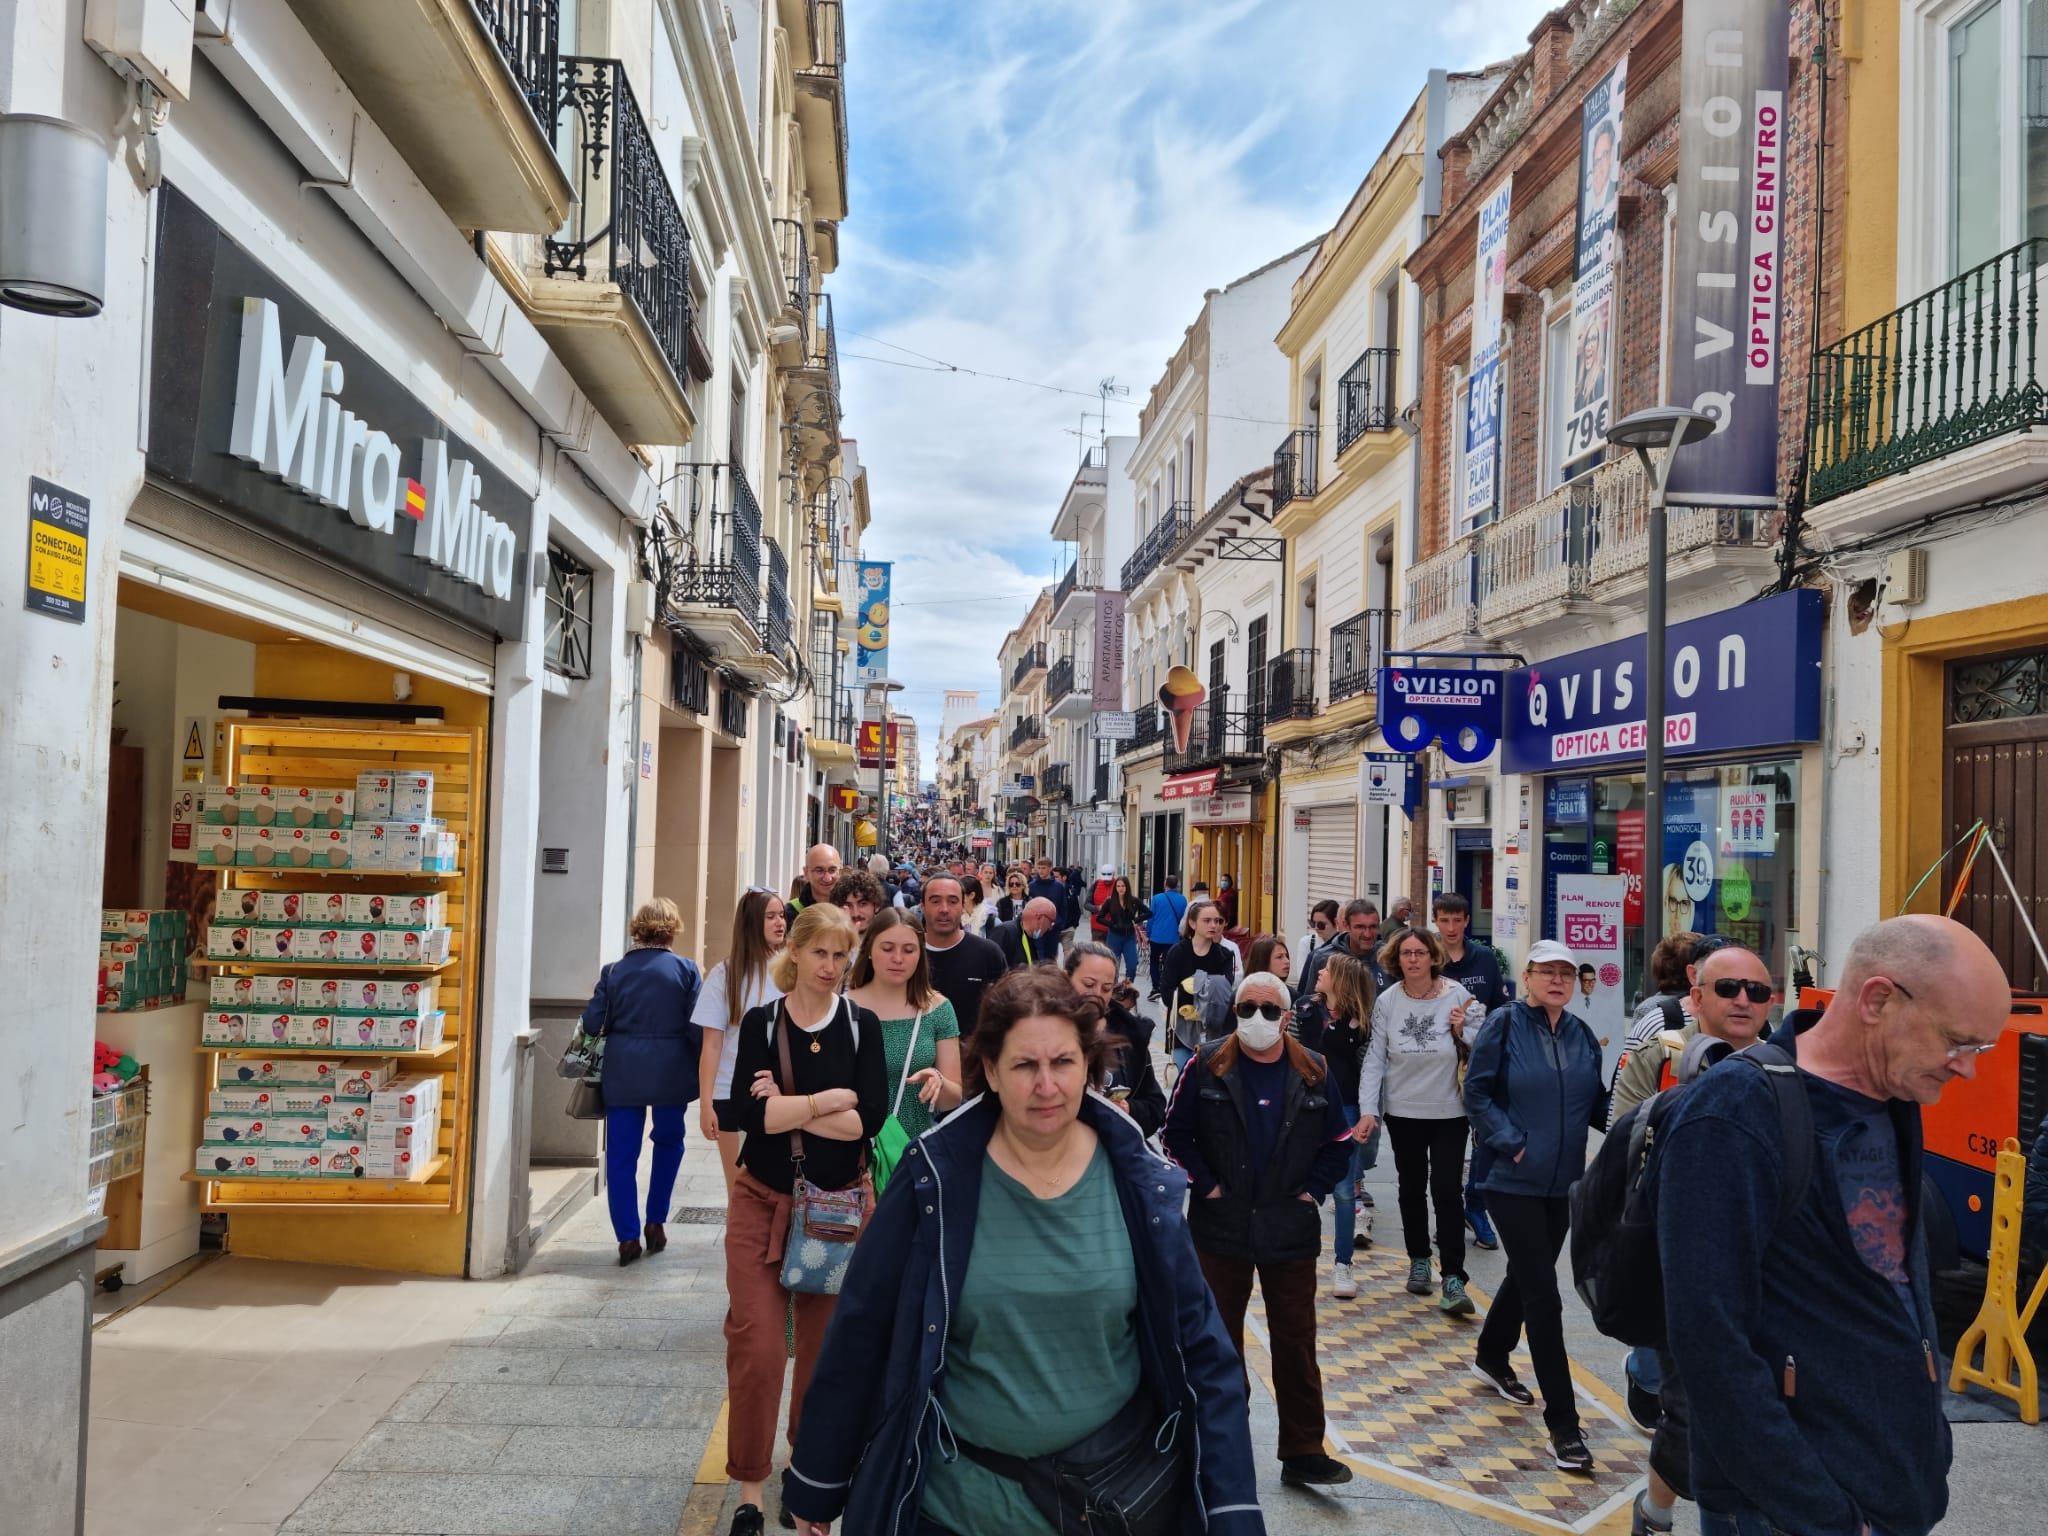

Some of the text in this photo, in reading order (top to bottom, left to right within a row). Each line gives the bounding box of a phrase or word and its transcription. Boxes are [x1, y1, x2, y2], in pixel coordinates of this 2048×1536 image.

[1481, 186, 1510, 234] PLAN
[1480, 216, 1510, 257] RENOVE
[1747, 106, 1778, 369] ÓPTICA CENTRO
[1577, 261, 1614, 297] CRISTALES
[1575, 280, 1613, 318] INCLUIDOS
[1469, 364, 1499, 432] 50€
[1567, 400, 1609, 457] 79€
[229, 296, 517, 602] Mira Mira
[1469, 460, 1491, 490] PLAN
[35, 532, 83, 558] CONECTADA
[1101, 599, 1113, 683] APARTAMENTOS
[1529, 633, 1746, 728] QVISOn
[1443, 696, 1480, 705] CENTRO
[1555, 717, 1692, 758] ÓPTICA CENRO
[1559, 799, 1587, 815] GRATIS
[1666, 823, 1708, 834] MONOFOCALES
[1561, 894, 1584, 902] PLAN
[1570, 924, 1613, 942] 50€
[1967, 1133, 1998, 1158] C38
